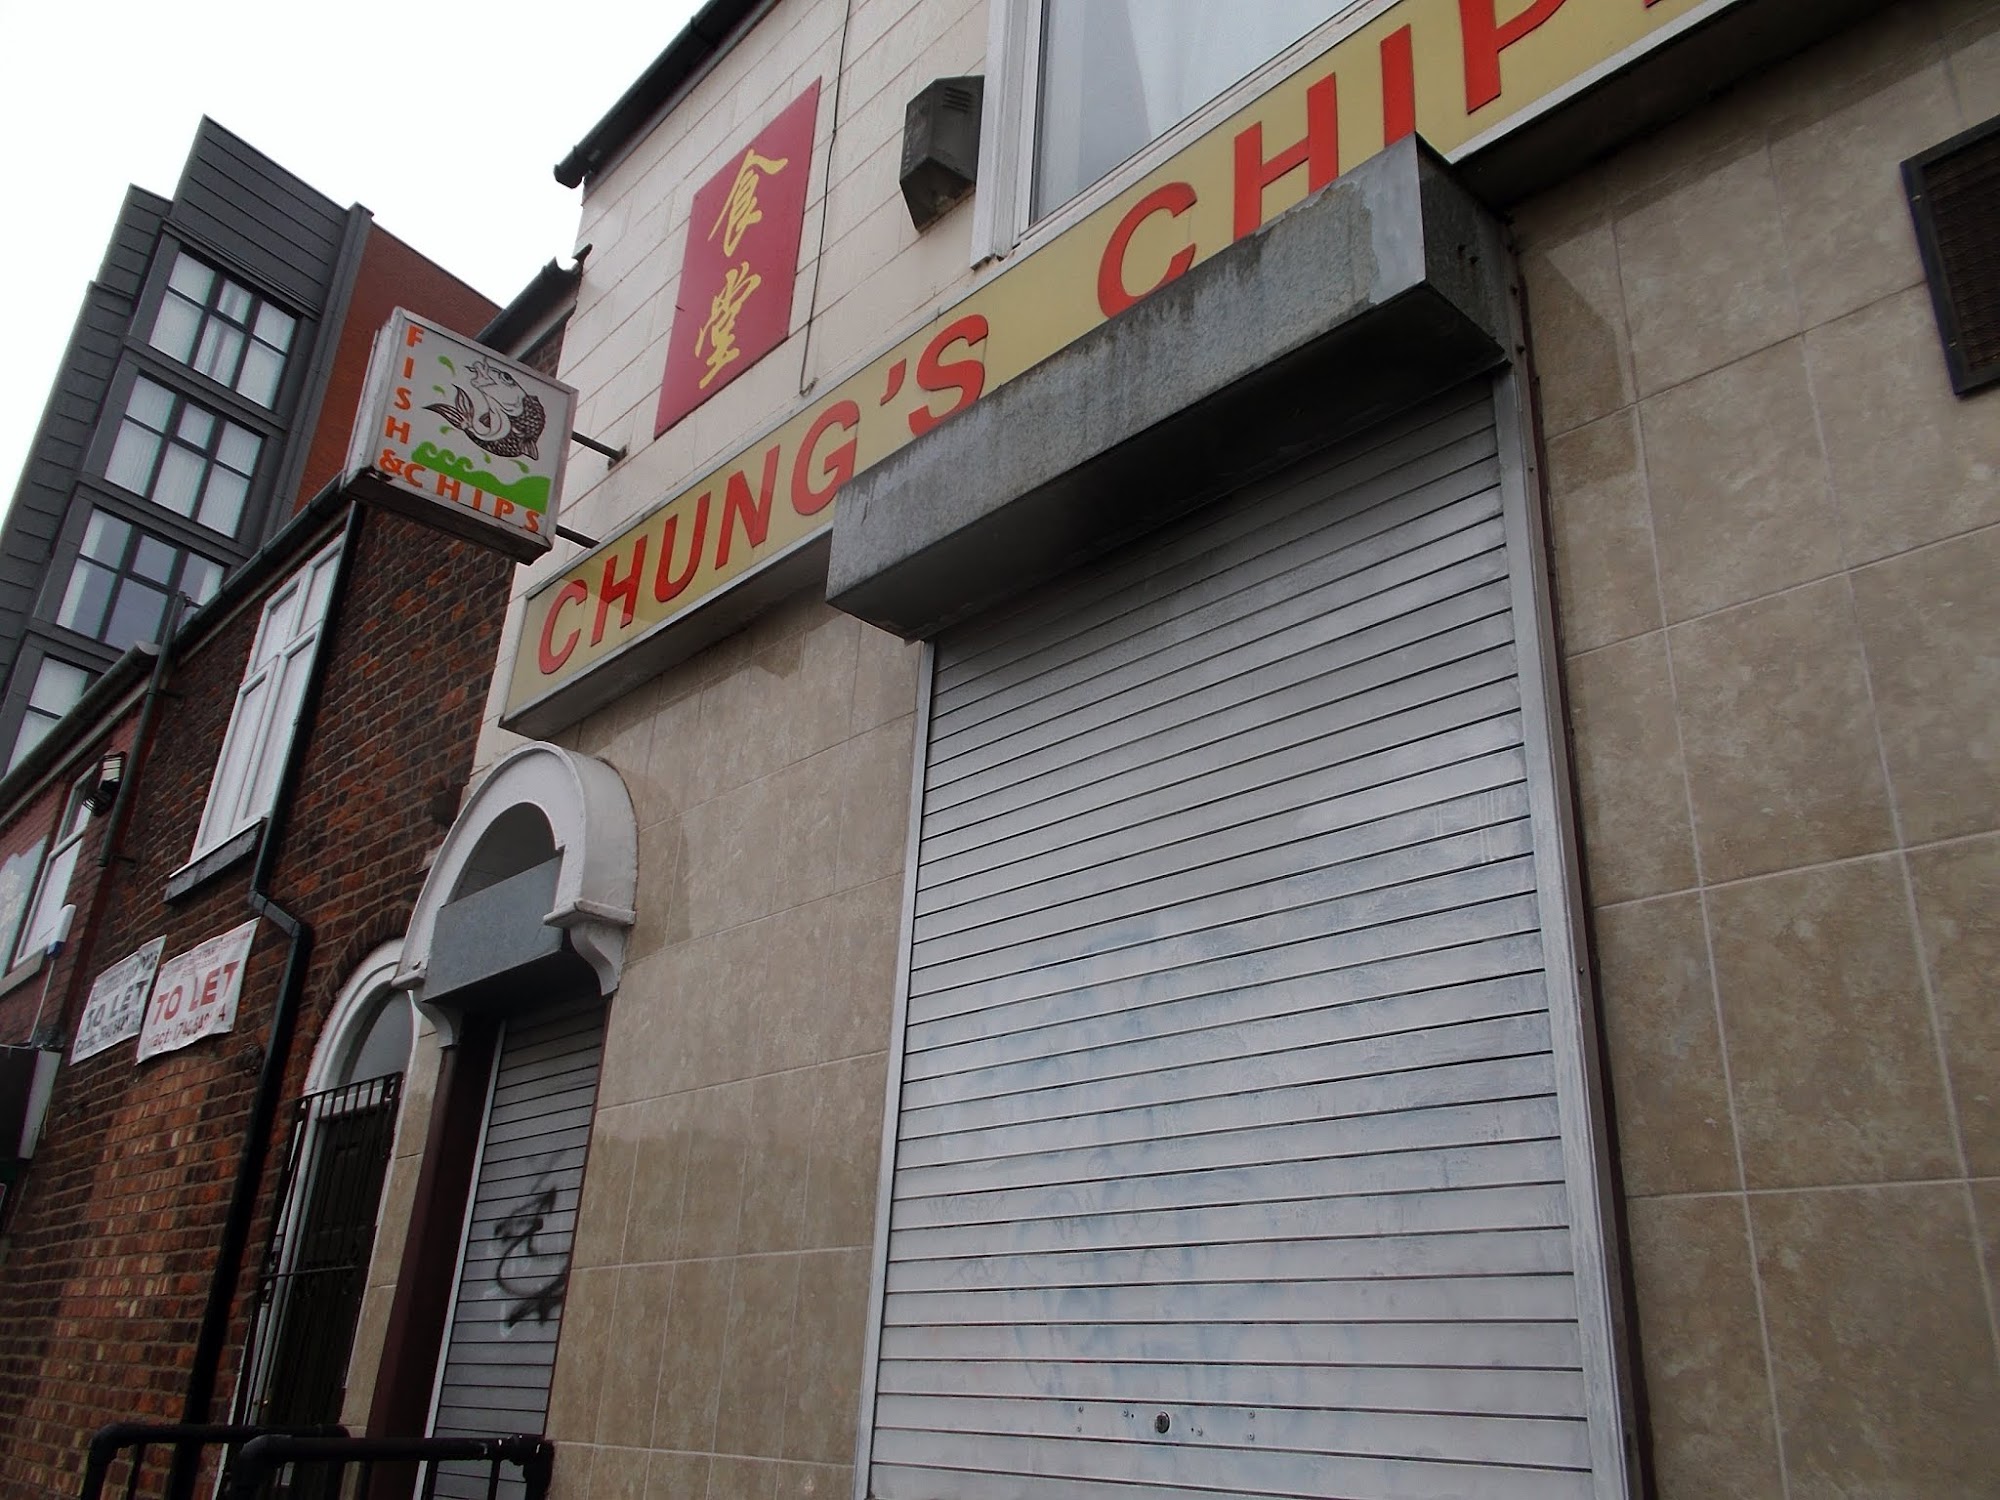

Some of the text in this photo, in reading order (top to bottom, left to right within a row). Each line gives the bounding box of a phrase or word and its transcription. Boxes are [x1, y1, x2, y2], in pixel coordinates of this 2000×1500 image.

[537, 0, 1664, 675] CHUNG'S CHIP
[384, 325, 424, 444] FISH
[404, 460, 540, 532] CHIPS
[84, 979, 149, 1033] TO LET
[153, 985, 183, 1025] TO
[188, 961, 240, 1012] LET
